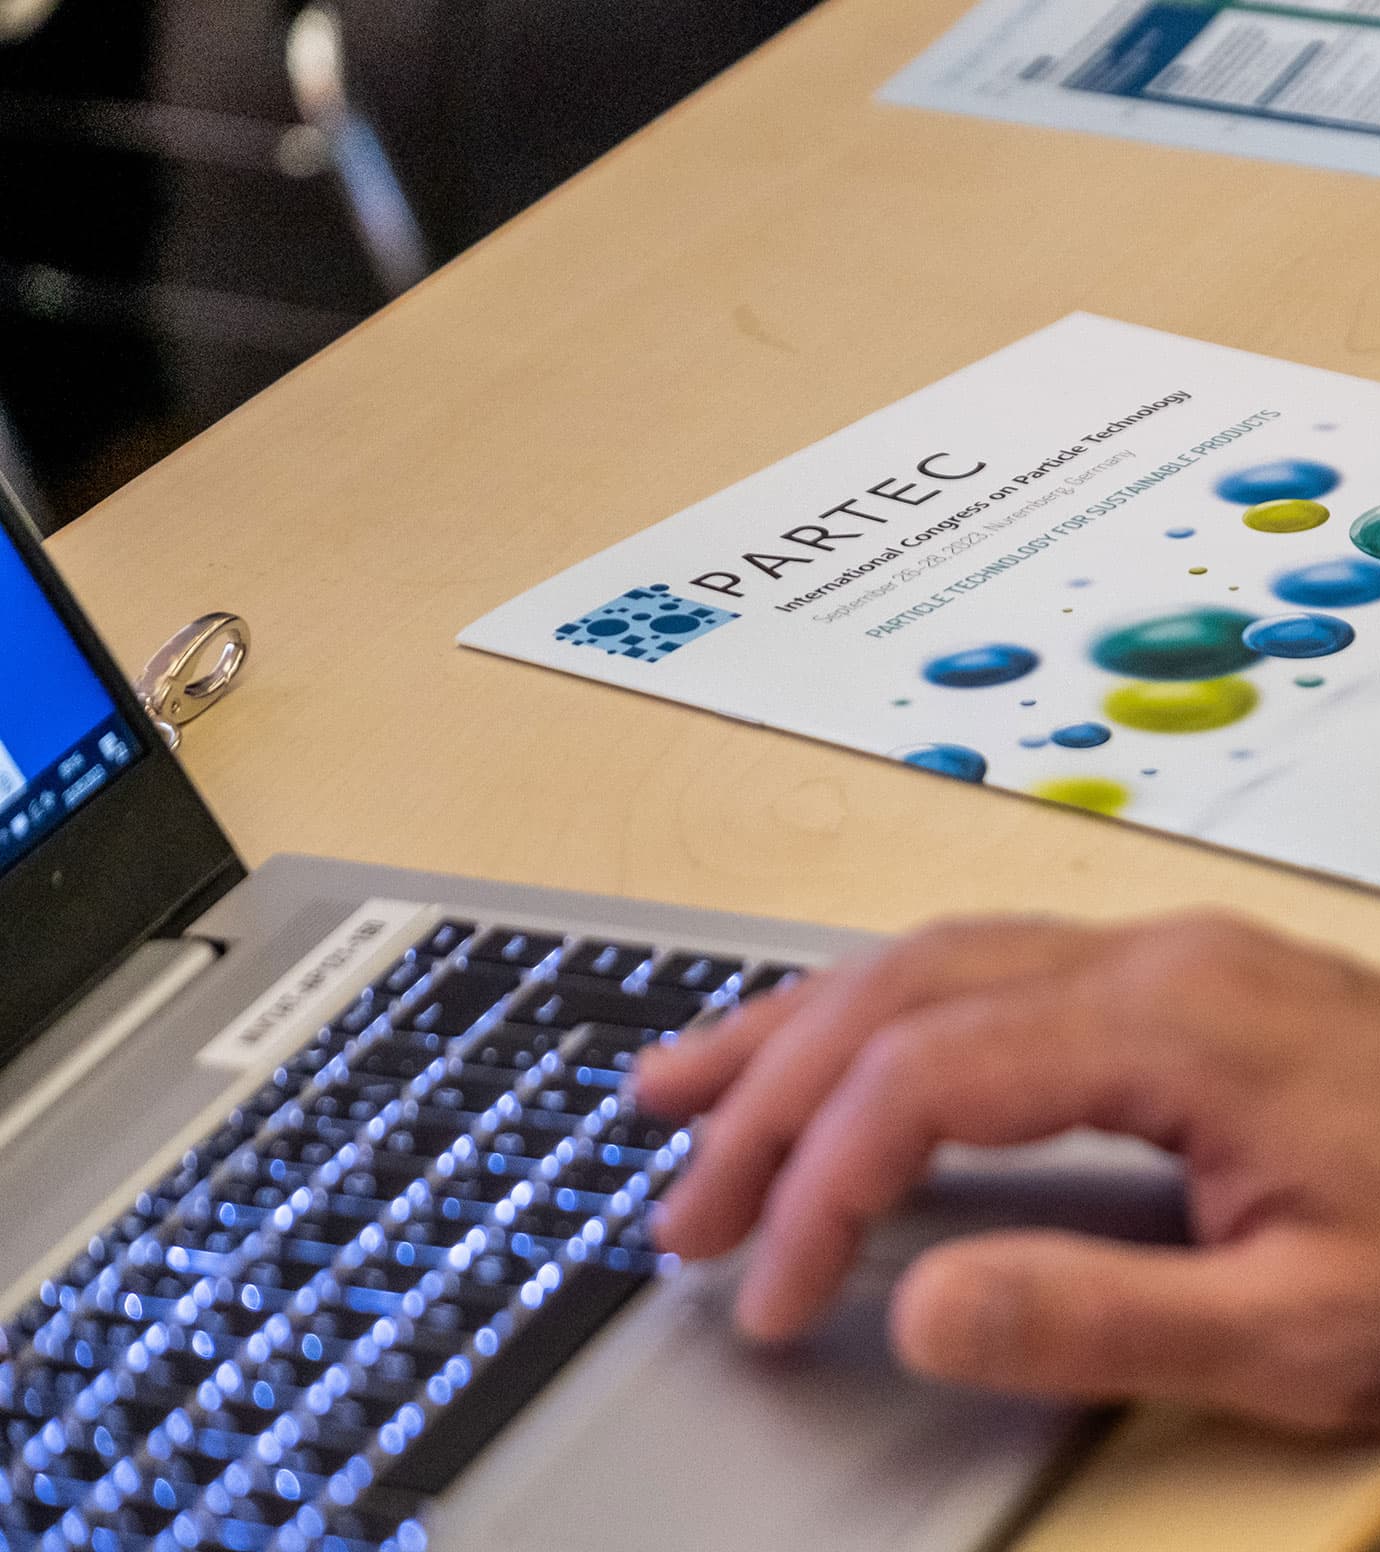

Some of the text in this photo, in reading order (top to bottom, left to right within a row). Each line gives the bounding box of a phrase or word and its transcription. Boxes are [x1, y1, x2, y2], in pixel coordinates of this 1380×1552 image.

[689, 452, 987, 598] PARTEC
[775, 390, 1193, 613] International Congress on Particle Technology
[812, 581, 899, 624] September
[1063, 449, 1137, 486] Germany
[865, 408, 1281, 639] PARTICLE TECHNOLOGY FOR SUSTAINABLE PRODUCTS
